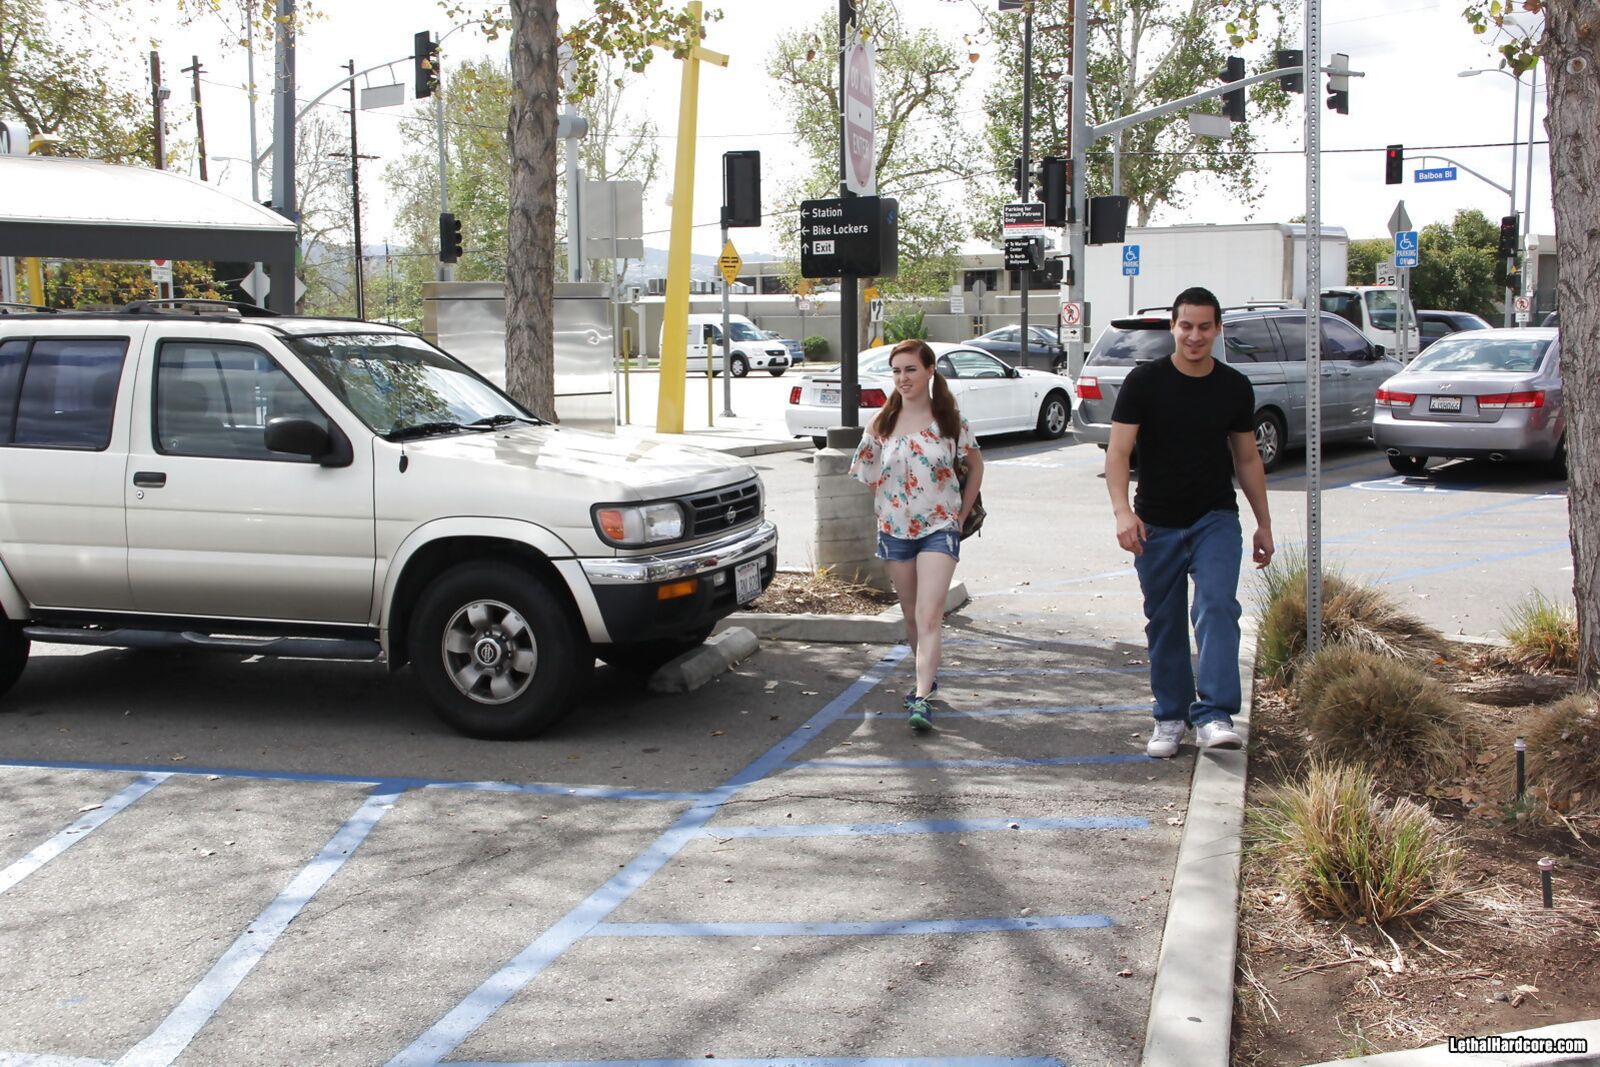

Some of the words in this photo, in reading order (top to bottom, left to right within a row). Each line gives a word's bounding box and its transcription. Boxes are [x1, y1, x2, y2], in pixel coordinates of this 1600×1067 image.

[853, 132, 870, 160] ENTER
[1418, 171, 1443, 180] Balboa
[1444, 170, 1453, 178] Bl
[812, 206, 843, 218] Station
[812, 225, 832, 235] Bike
[833, 223, 869, 234] Lockers
[815, 242, 832, 253] Exit
[1378, 275, 1396, 286] 25
